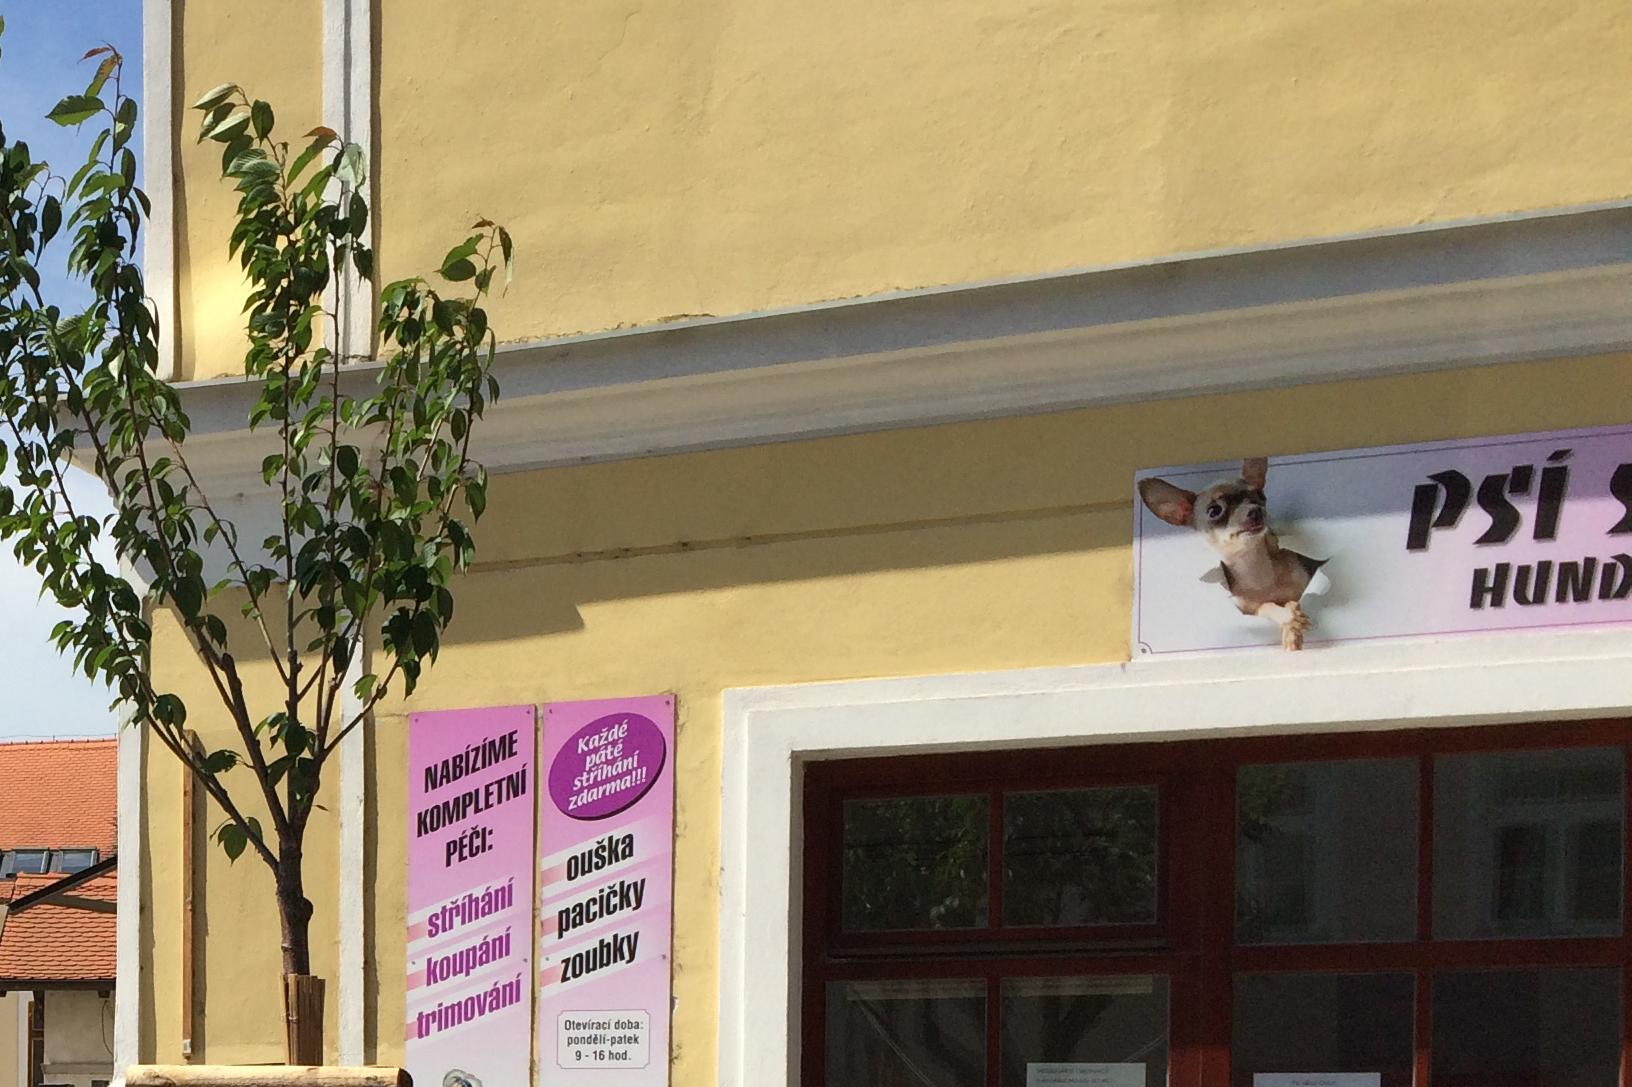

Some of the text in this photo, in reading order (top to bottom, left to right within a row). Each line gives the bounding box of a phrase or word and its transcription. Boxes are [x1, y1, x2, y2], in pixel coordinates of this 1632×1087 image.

[1406, 448, 1572, 551] PSÍ
[424, 729, 519, 794] NABÍZÍME
[577, 719, 629, 754] Každé
[585, 739, 623, 771] páté
[568, 766, 647, 811] zdarma!!!
[573, 750, 639, 791] stříhání
[416, 762, 528, 838] KOMPLETNÍ
[445, 824, 494, 868] PÉČI:
[566, 832, 635, 882] ouška
[427, 876, 515, 938] stříhání
[557, 878, 646, 940] pacičky
[425, 926, 512, 987] koupání
[560, 931, 640, 983] zoubky
[416, 972, 522, 1039] trimování
[564, 1018, 644, 1031] Otevírací doba:
[575, 1050, 582, 1061] 9
[592, 1050, 605, 1061] 16
[608, 1050, 632, 1061] hod.
